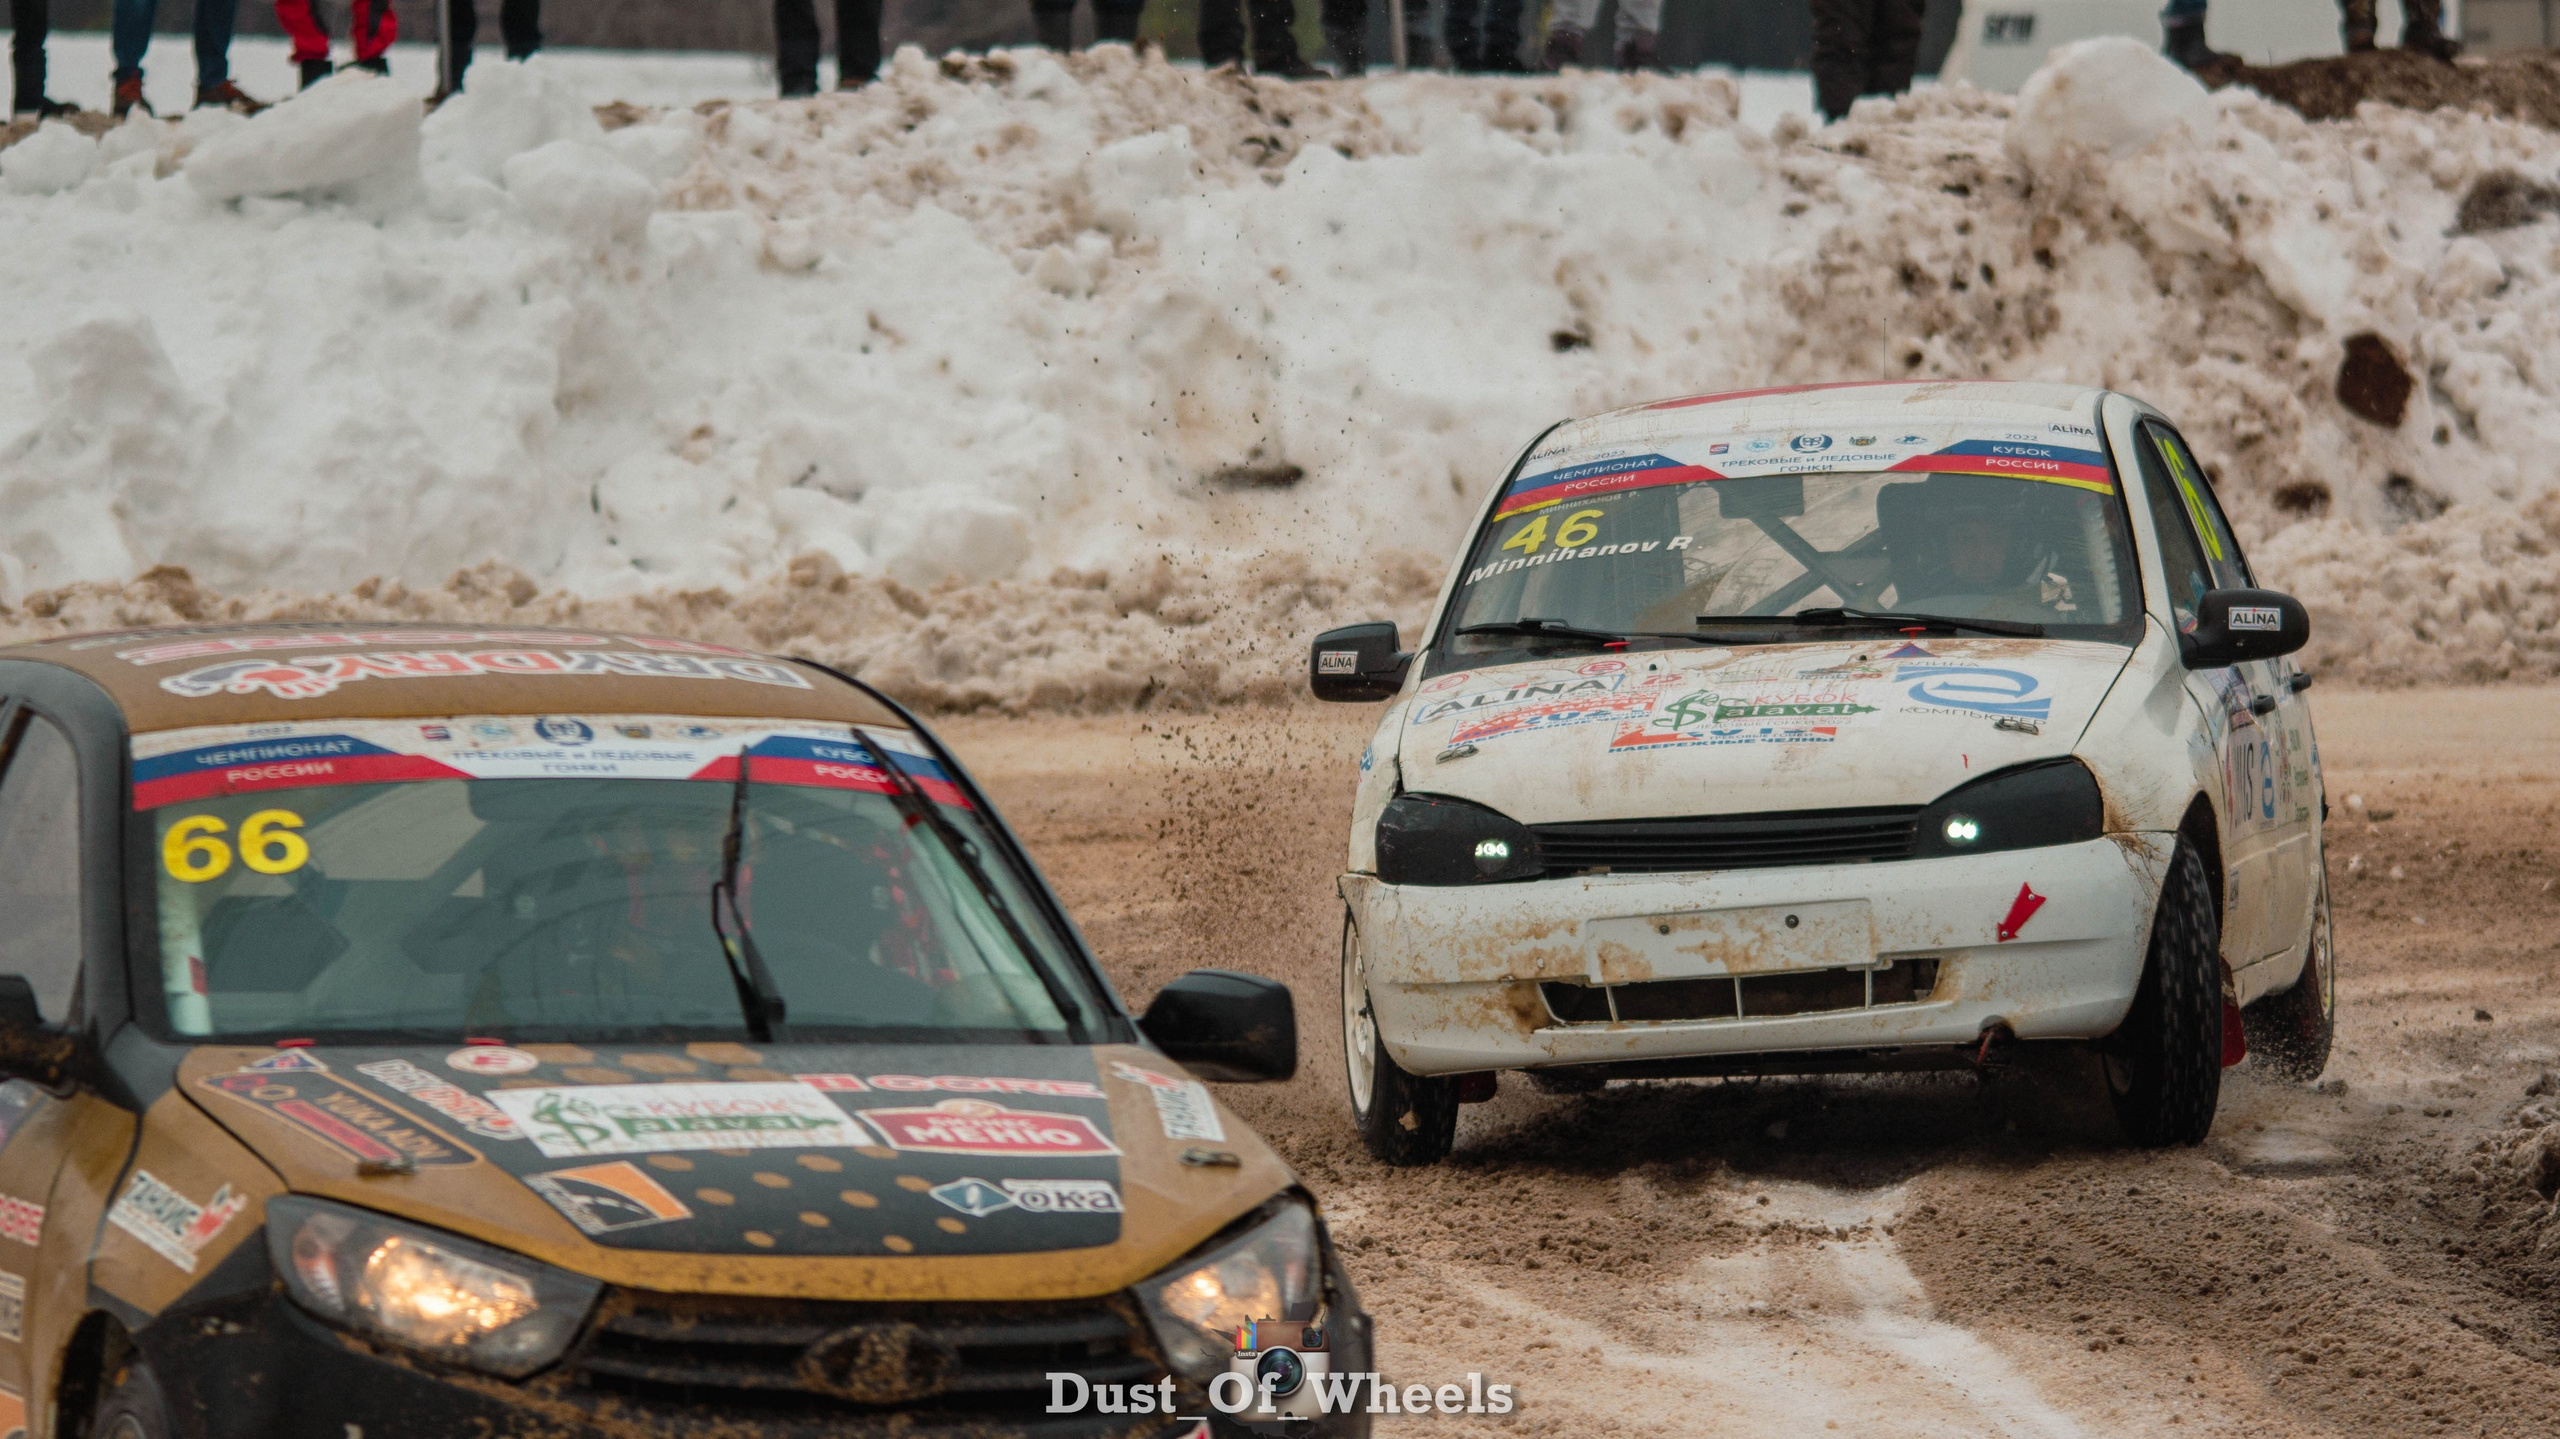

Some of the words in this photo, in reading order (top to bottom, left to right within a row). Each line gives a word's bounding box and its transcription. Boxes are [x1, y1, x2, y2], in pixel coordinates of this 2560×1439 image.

[2005, 433, 2038, 442] 2022
[2052, 424, 2095, 436] ALINA
[1992, 446, 2051, 457] КУБОК
[1720, 456, 1802, 468] ТРЕКОВЫЕ
[1818, 453, 1897, 463] ЛЕДОВЫЕ
[1779, 464, 1833, 472] ГОНКИ
[1985, 458, 2060, 471] РОССИИ
[1553, 458, 1658, 481] ЧЕМПИОНАТ
[1564, 474, 1636, 492] РОССИИ
[1502, 509, 1605, 555] 46
[1465, 540, 1660, 586] Minnihanov
[2233, 608, 2277, 624] ALINA
[1321, 653, 1353, 668] ALINA
[1424, 679, 1608, 719] ALINA
[1754, 692, 1860, 705] КУБОК
[1608, 739, 1756, 753] НАБЕРЕЖНЫЕ
[1760, 736, 1836, 746] ЧЕЛНЫ
[195, 740, 355, 766] ЧЕМПИОНАТ
[453, 751, 570, 761] ТРЕКОВЫЕ
[591, 751, 697, 762] ЛЕДОВЫЕ
[811, 745, 880, 763] КУБО
[226, 762, 334, 784] РОССИИ
[542, 763, 619, 773] ГОНКИ
[161, 808, 310, 883] 66
[903, 1125, 1083, 1146] МЕНЮ
